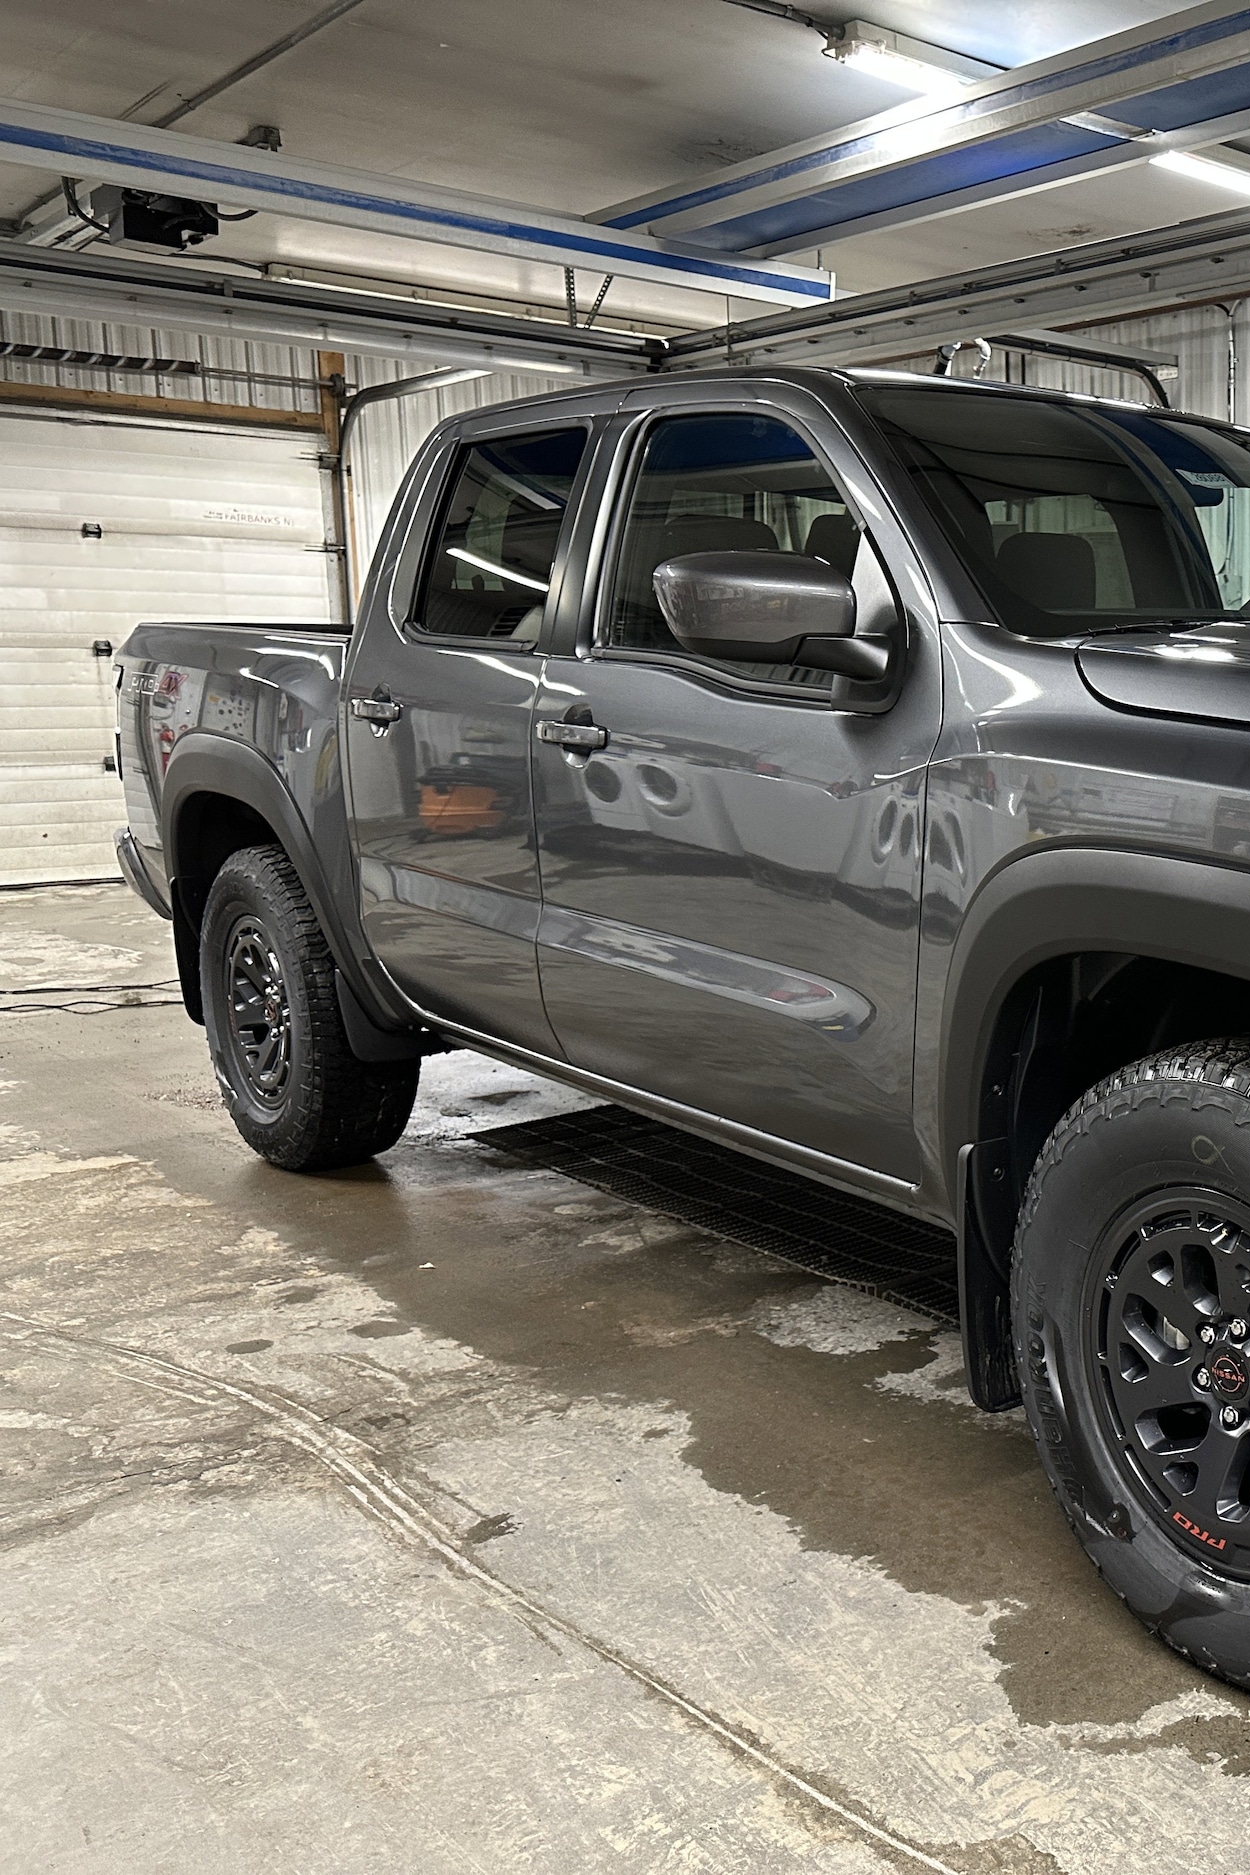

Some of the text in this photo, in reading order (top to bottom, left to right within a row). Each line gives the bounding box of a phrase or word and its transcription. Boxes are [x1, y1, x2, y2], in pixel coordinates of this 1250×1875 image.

[225, 514, 281, 525] FAIRBANKS
[1211, 1366, 1246, 1383] NISSAN
[1172, 1511, 1227, 1551] PRO
